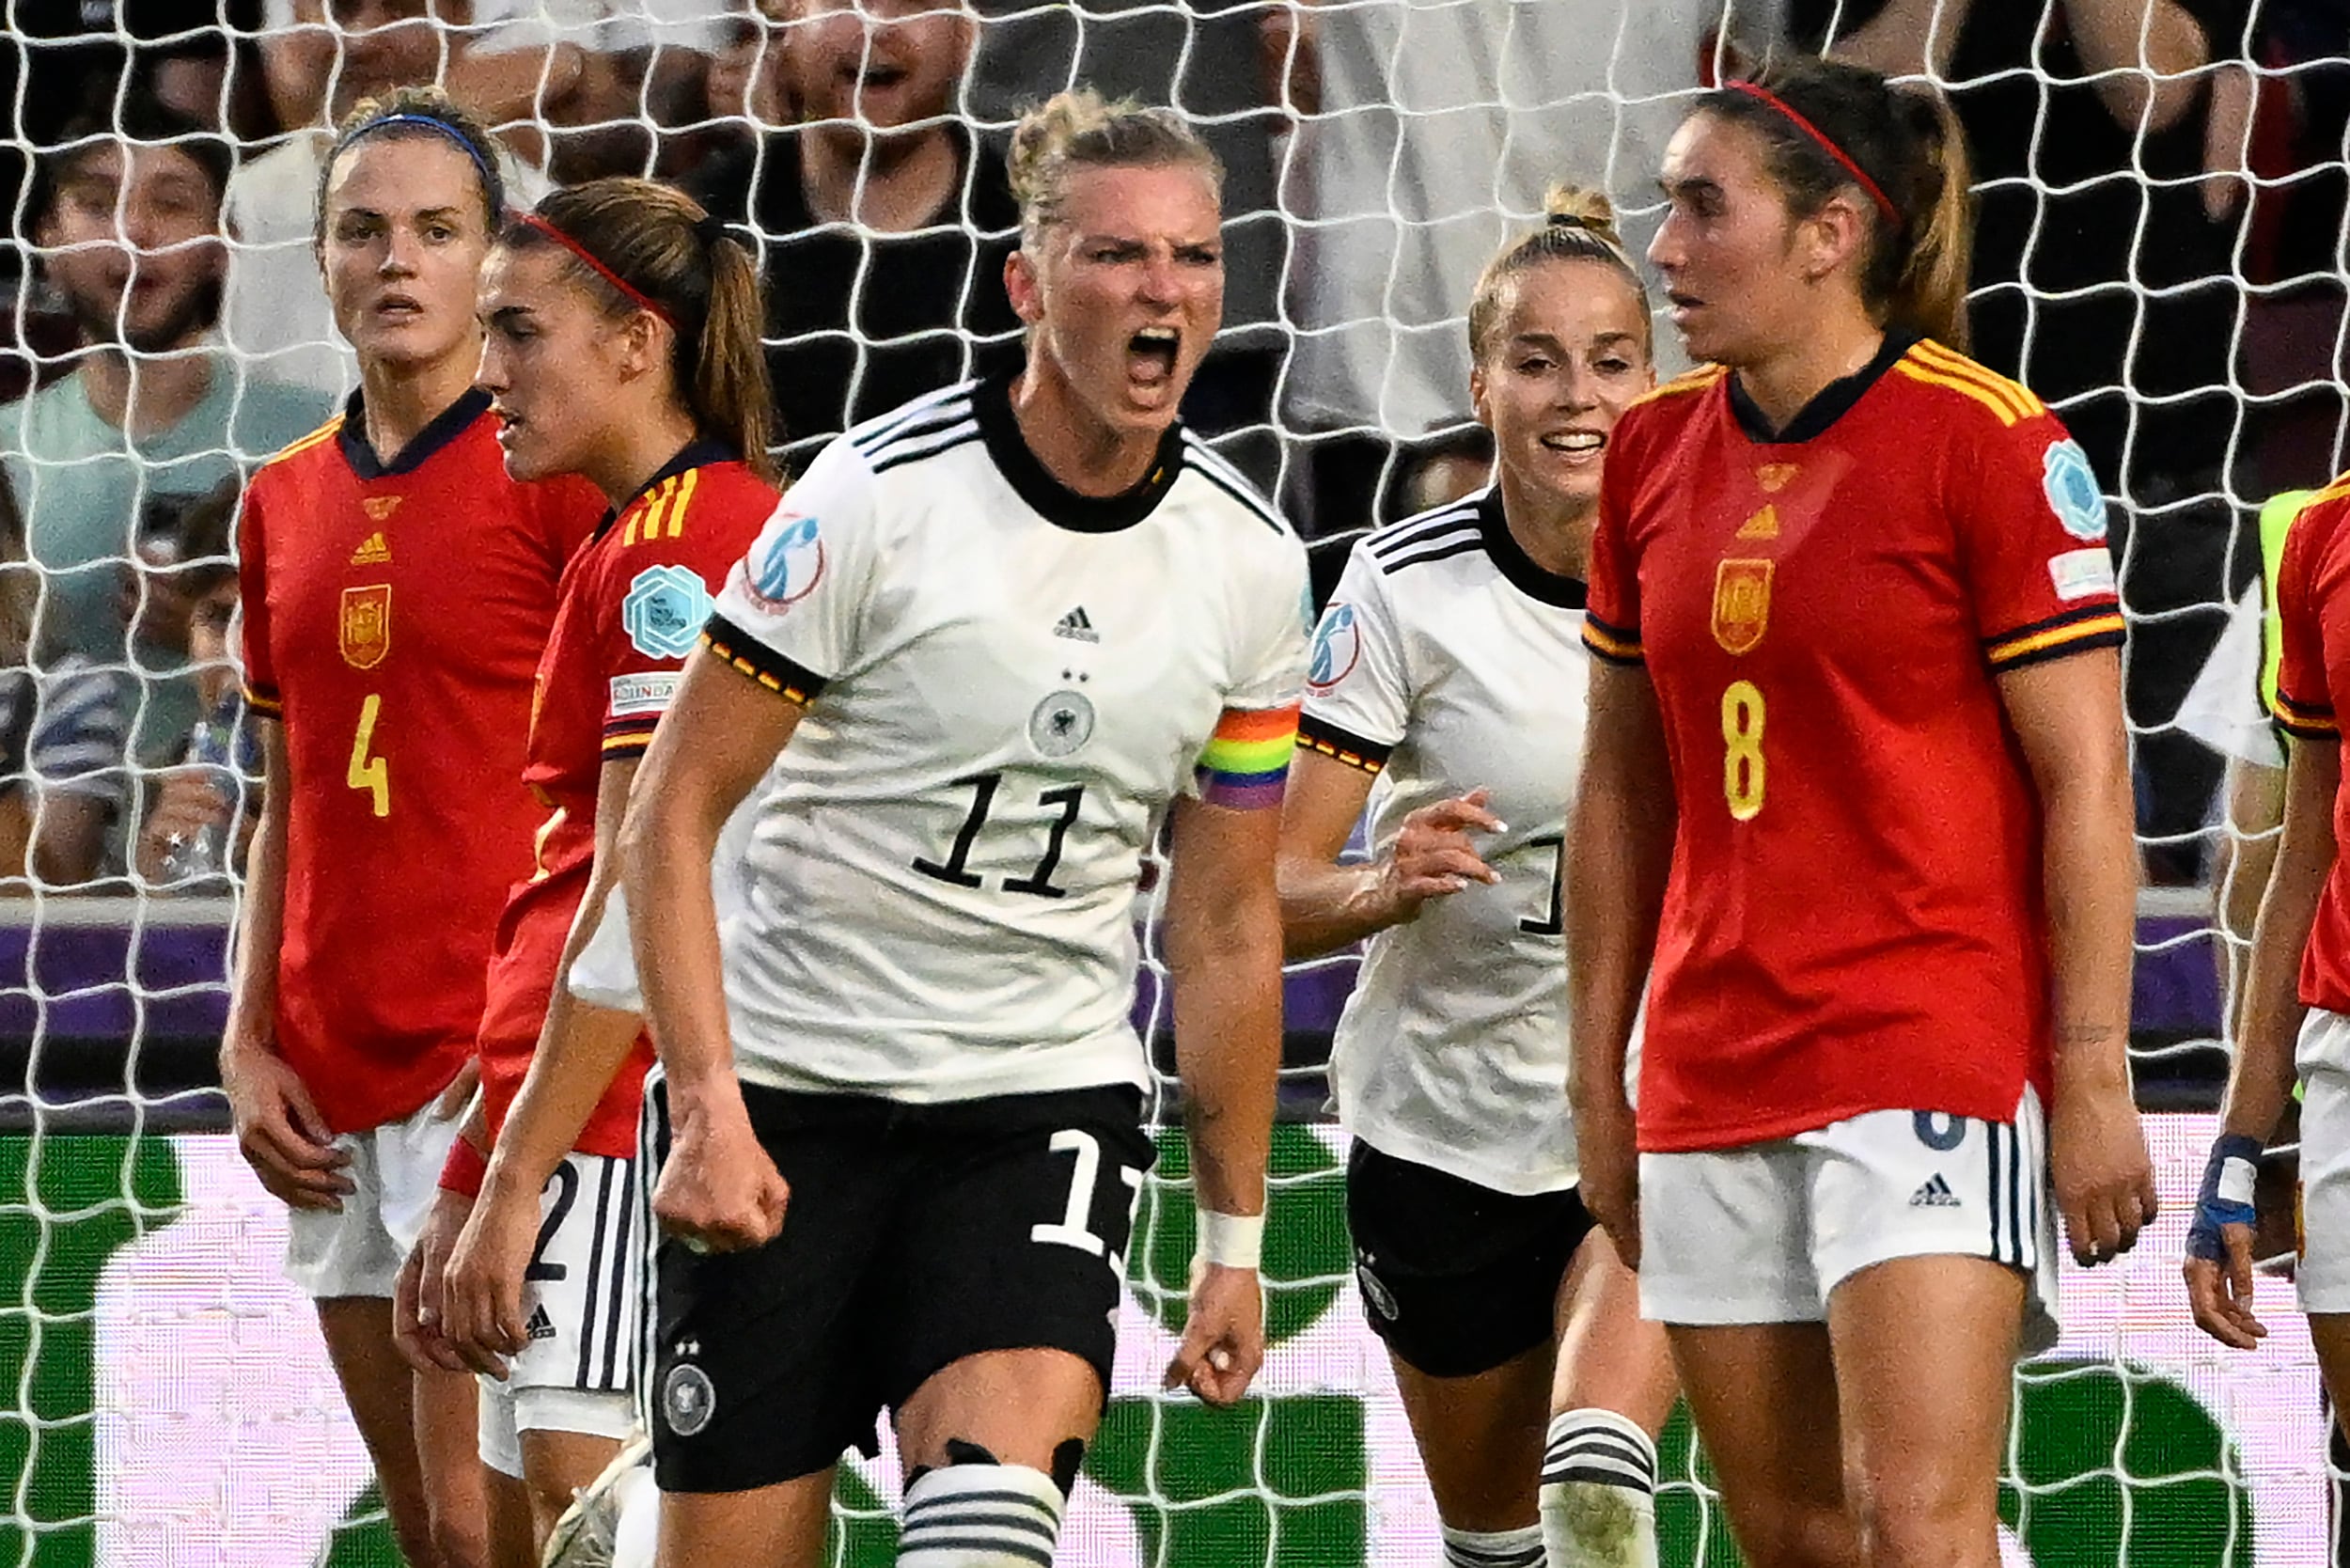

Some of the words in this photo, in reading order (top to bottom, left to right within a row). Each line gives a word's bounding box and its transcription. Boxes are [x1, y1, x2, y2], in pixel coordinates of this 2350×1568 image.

[347, 694, 389, 817] 4
[1722, 680, 1765, 821] 8
[912, 772, 1086, 898] 11
[525, 1159, 579, 1281] 2
